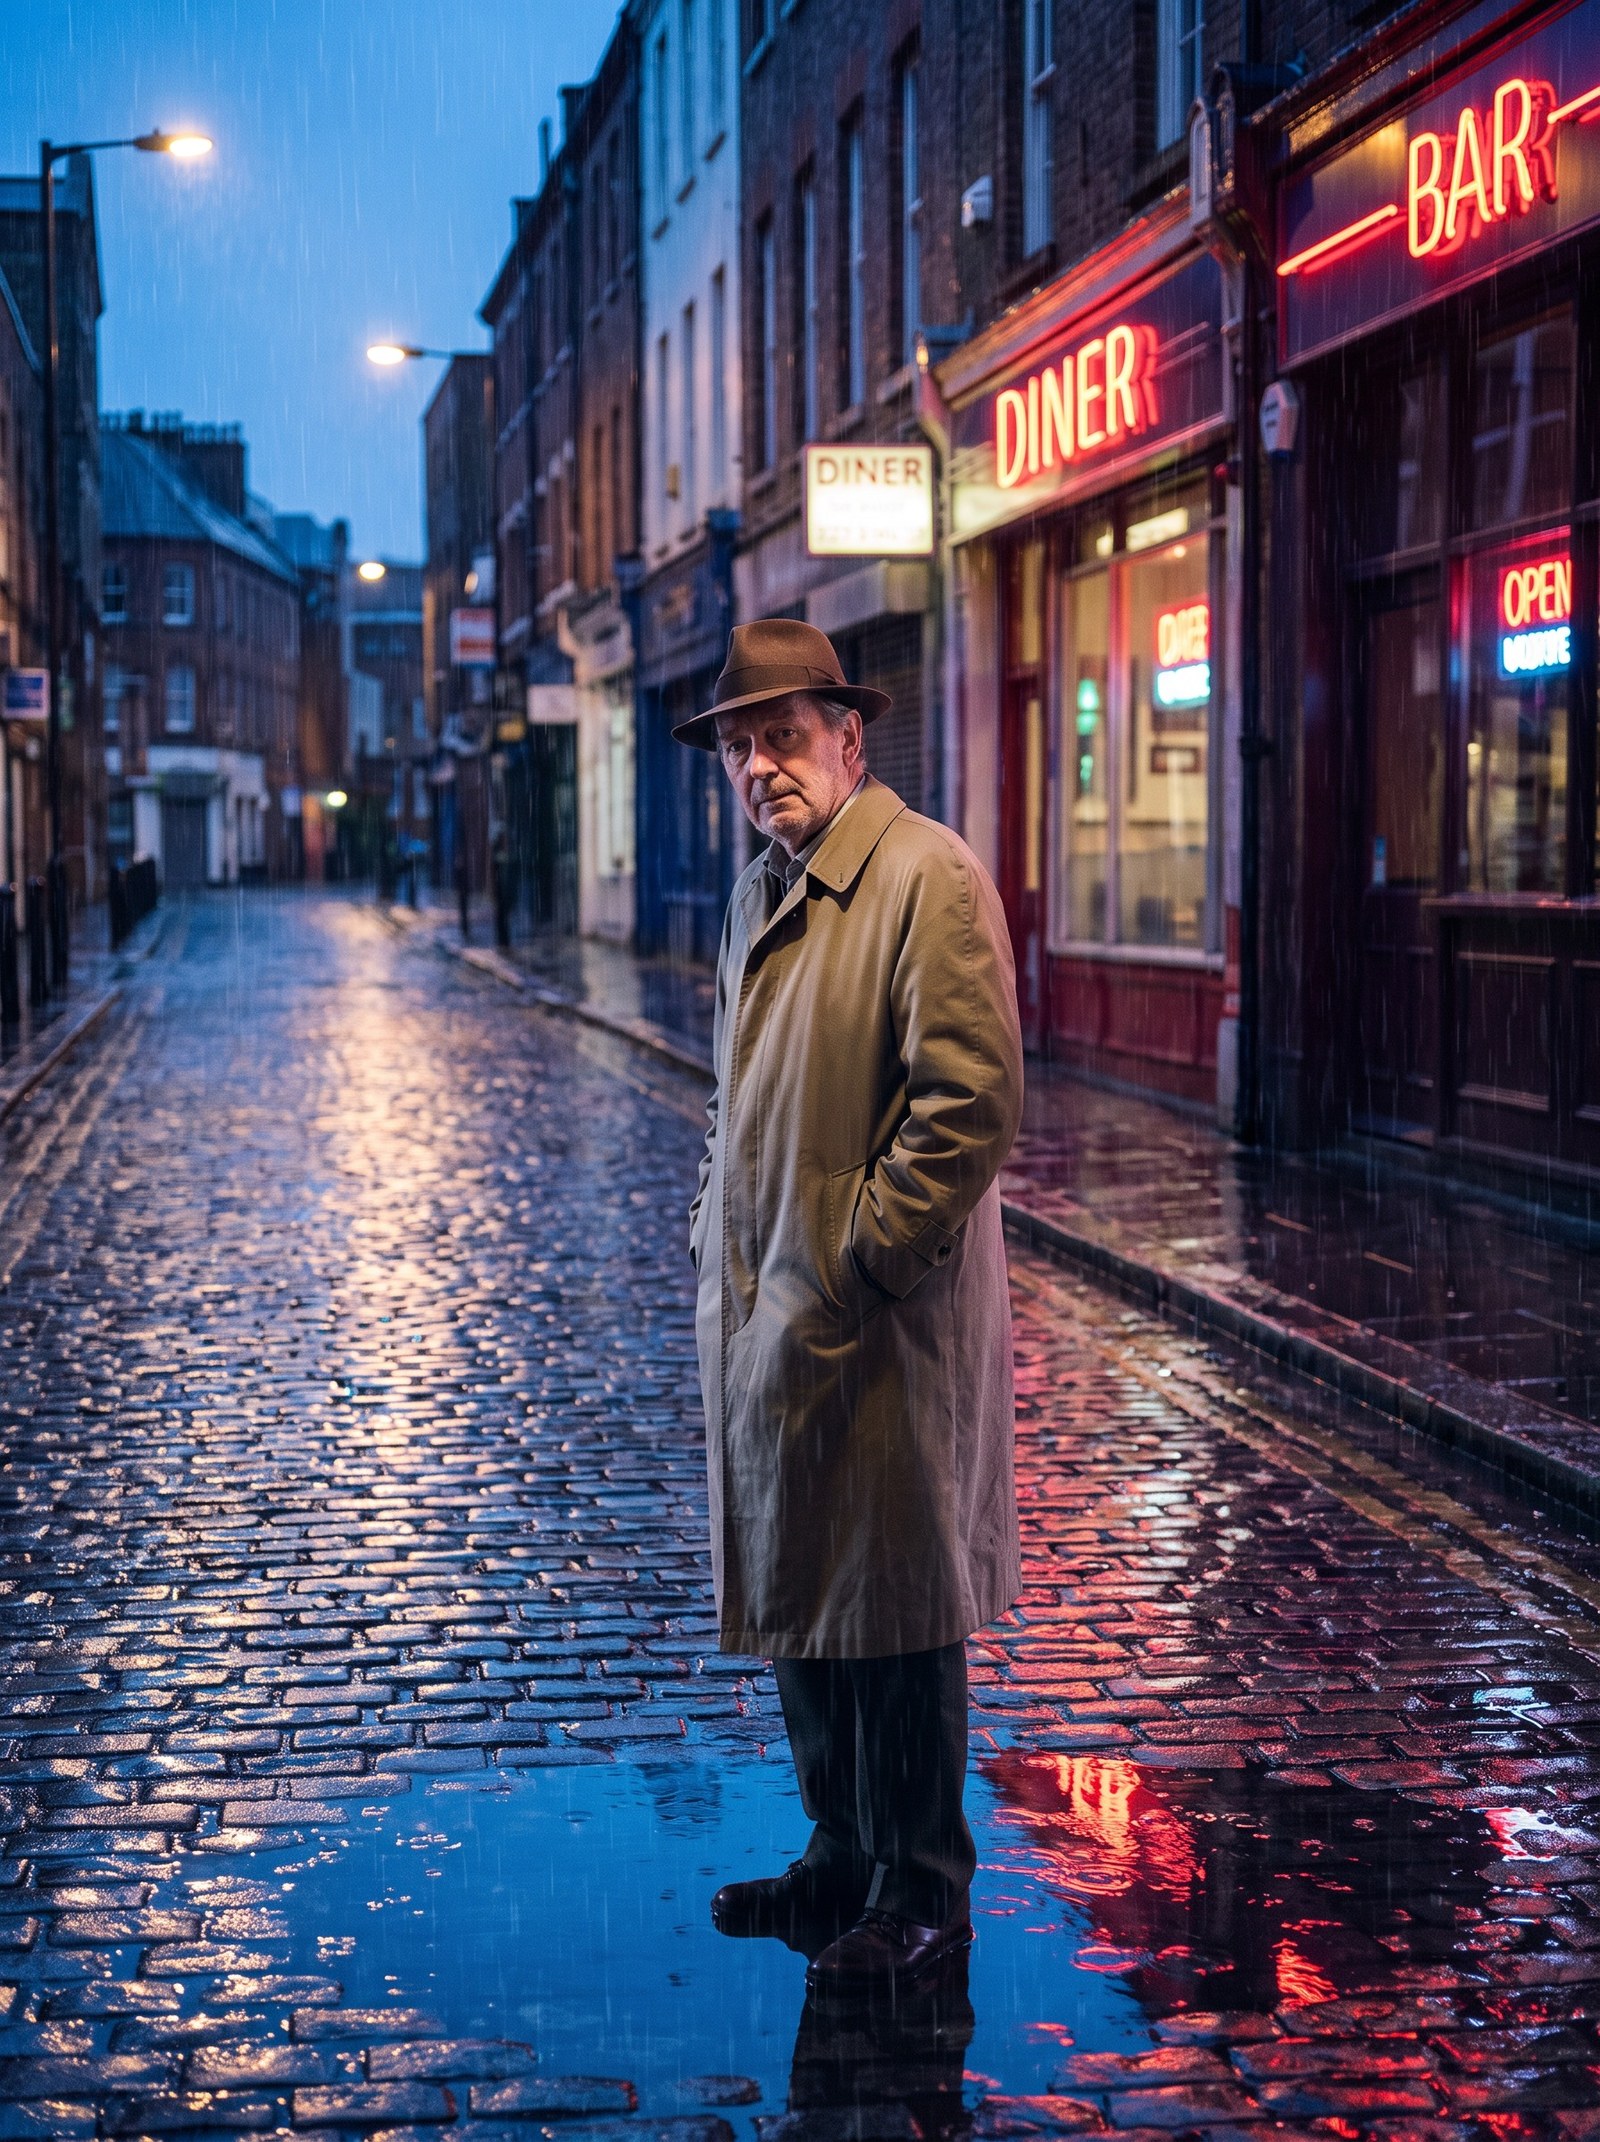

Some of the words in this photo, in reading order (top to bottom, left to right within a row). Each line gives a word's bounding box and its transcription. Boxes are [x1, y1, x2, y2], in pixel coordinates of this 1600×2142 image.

[1408, 78, 1535, 258] BAR
[996, 325, 1136, 488] DINER
[817, 457, 922, 485] DINER
[1503, 559, 1571, 627] OPEN
